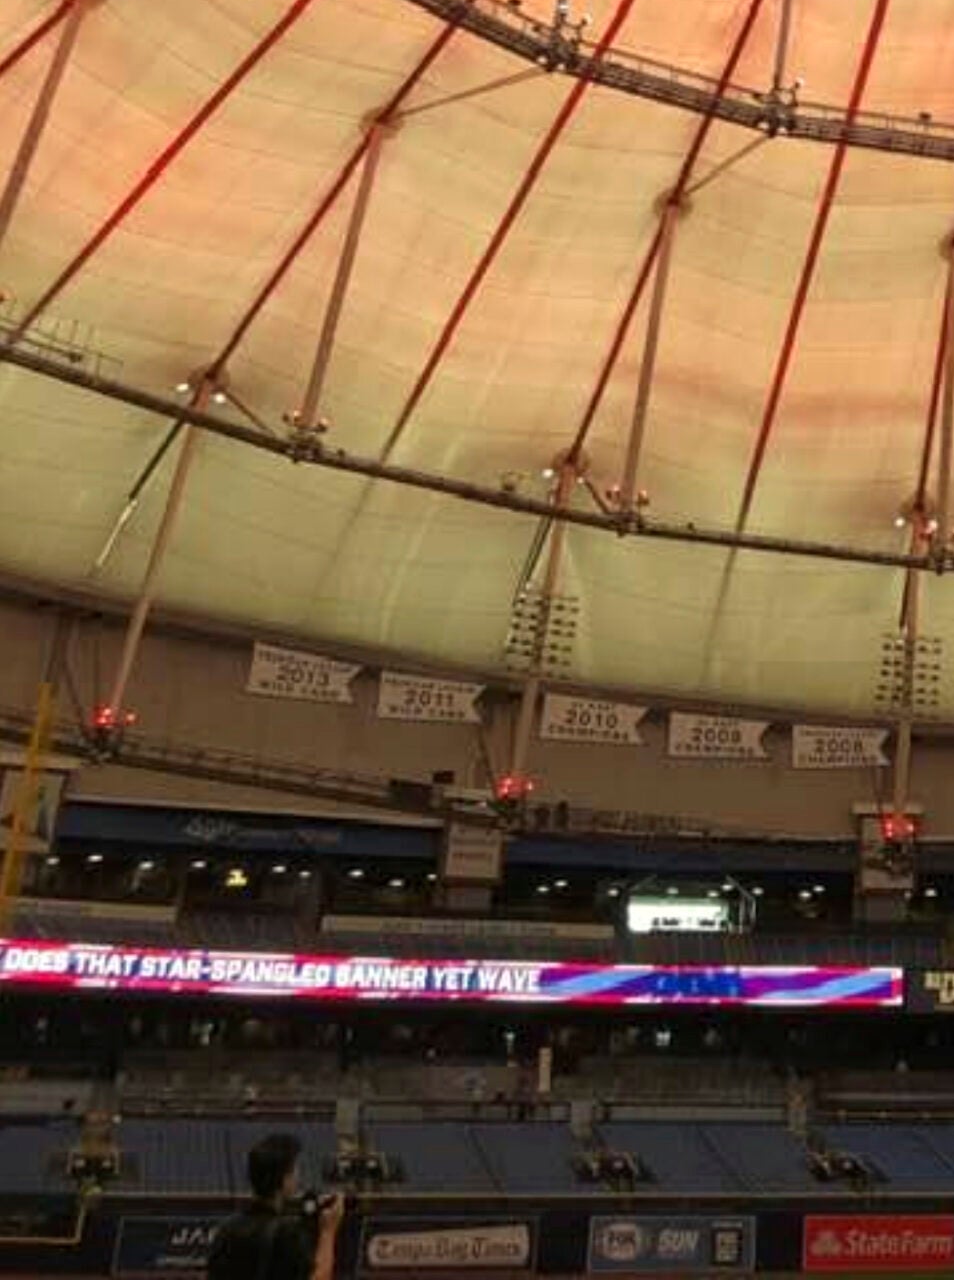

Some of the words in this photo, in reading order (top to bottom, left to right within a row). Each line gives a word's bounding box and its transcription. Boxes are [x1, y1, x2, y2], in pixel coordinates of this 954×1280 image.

[404, 689, 454, 706] 2011
[565, 709, 618, 729] 2010
[4, 949, 68, 973] DOES
[75, 952, 138, 977] THAT
[140, 955, 331, 986] STAR-SPANGLED
[335, 964, 426, 988] BANNER
[433, 967, 476, 990] YET
[478, 967, 540, 991] WAVE
